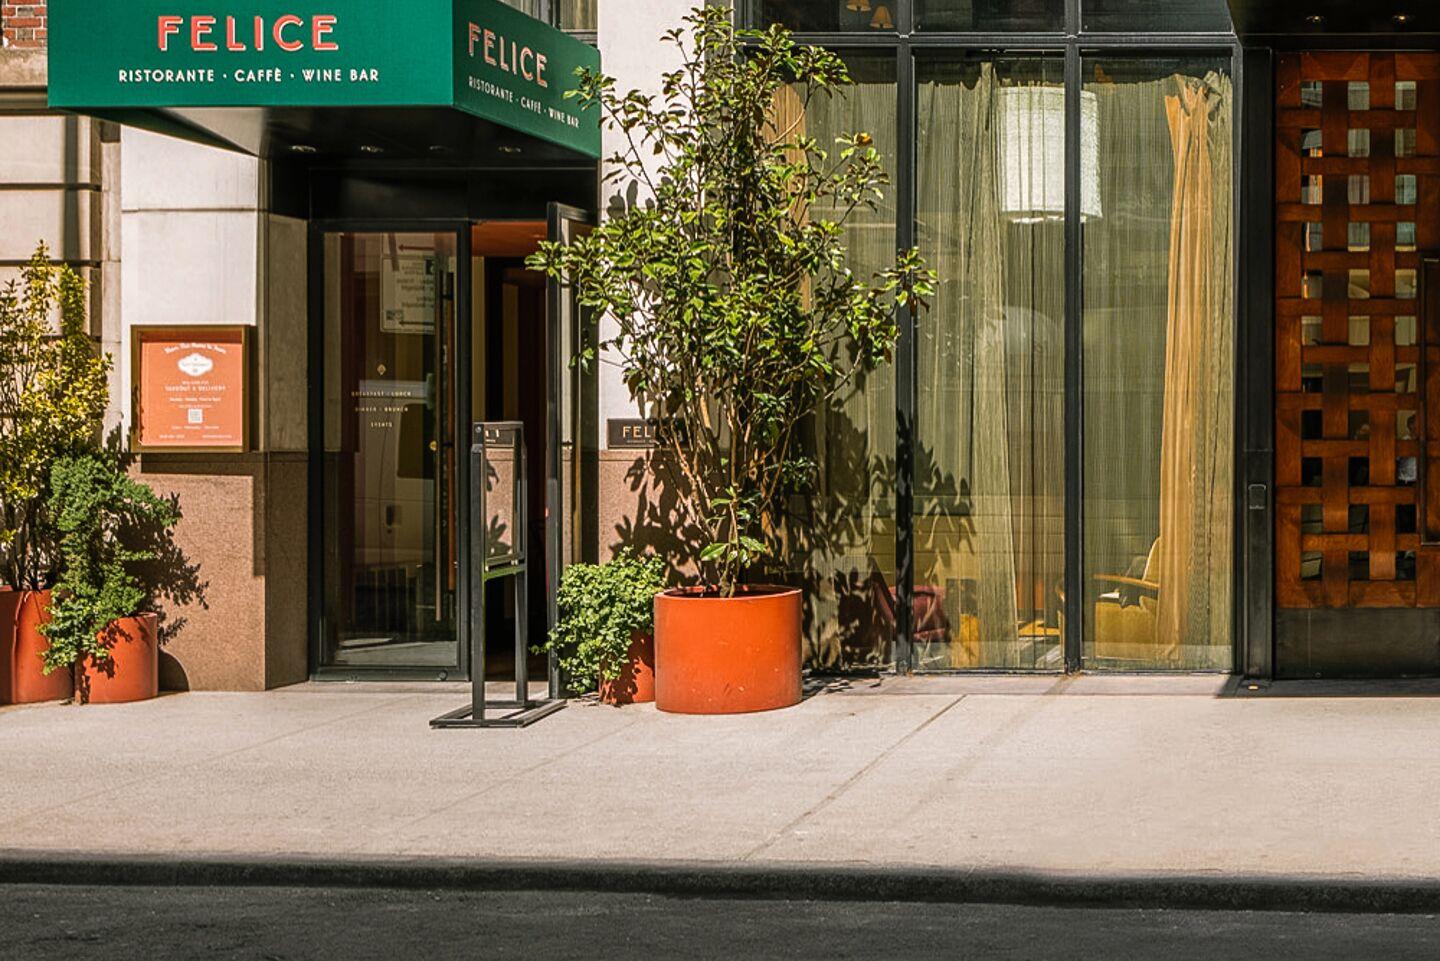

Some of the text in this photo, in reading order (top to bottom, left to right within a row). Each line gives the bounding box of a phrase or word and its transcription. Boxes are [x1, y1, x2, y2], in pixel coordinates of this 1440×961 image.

[157, 14, 339, 52] FELICE
[468, 21, 549, 88] FELICE
[118, 67, 379, 82] RISTORANTE CAFFÈ WINE BAR
[468, 76, 513, 102] RISTORANTE
[548, 107, 565, 123] WINE
[567, 114, 580, 129] BAR
